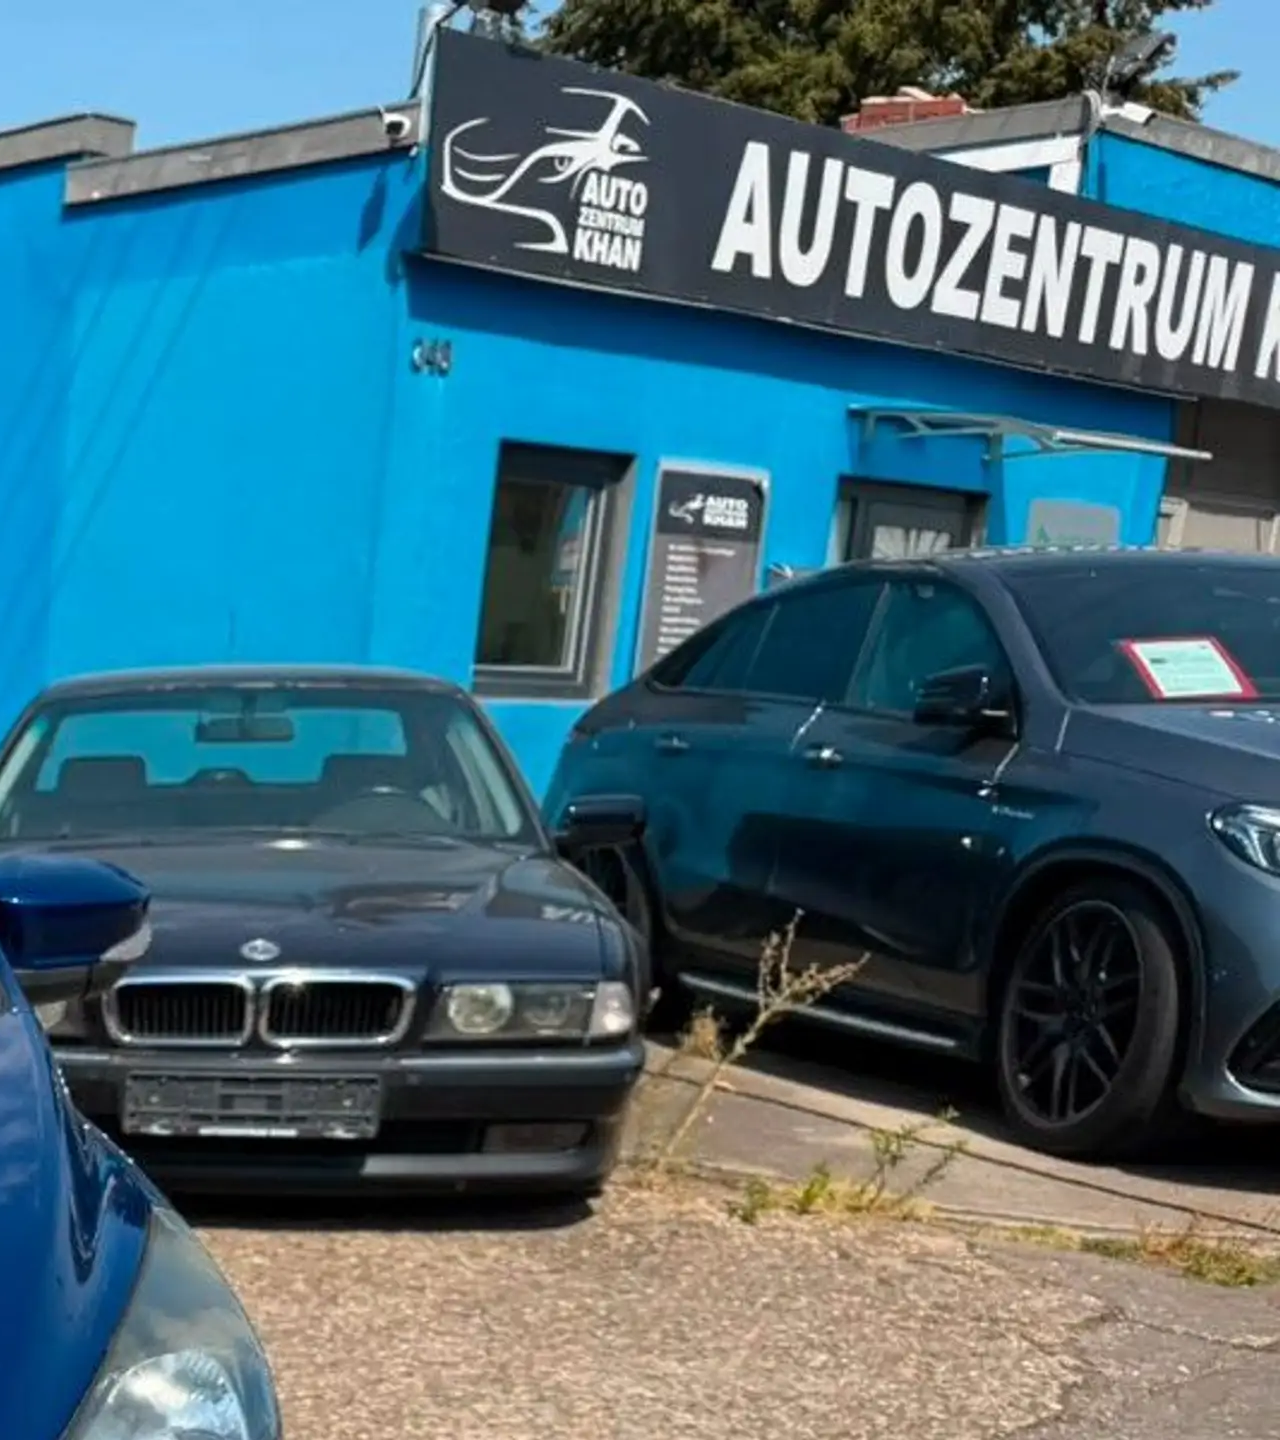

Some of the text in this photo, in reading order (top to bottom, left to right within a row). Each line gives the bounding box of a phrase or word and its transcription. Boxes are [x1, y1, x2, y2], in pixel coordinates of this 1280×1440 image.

[581, 171, 648, 217] AUTO
[577, 205, 645, 238] ZENTRUM
[573, 227, 643, 272] KHAN
[711, 140, 1254, 373] AUTOZENTRUM
